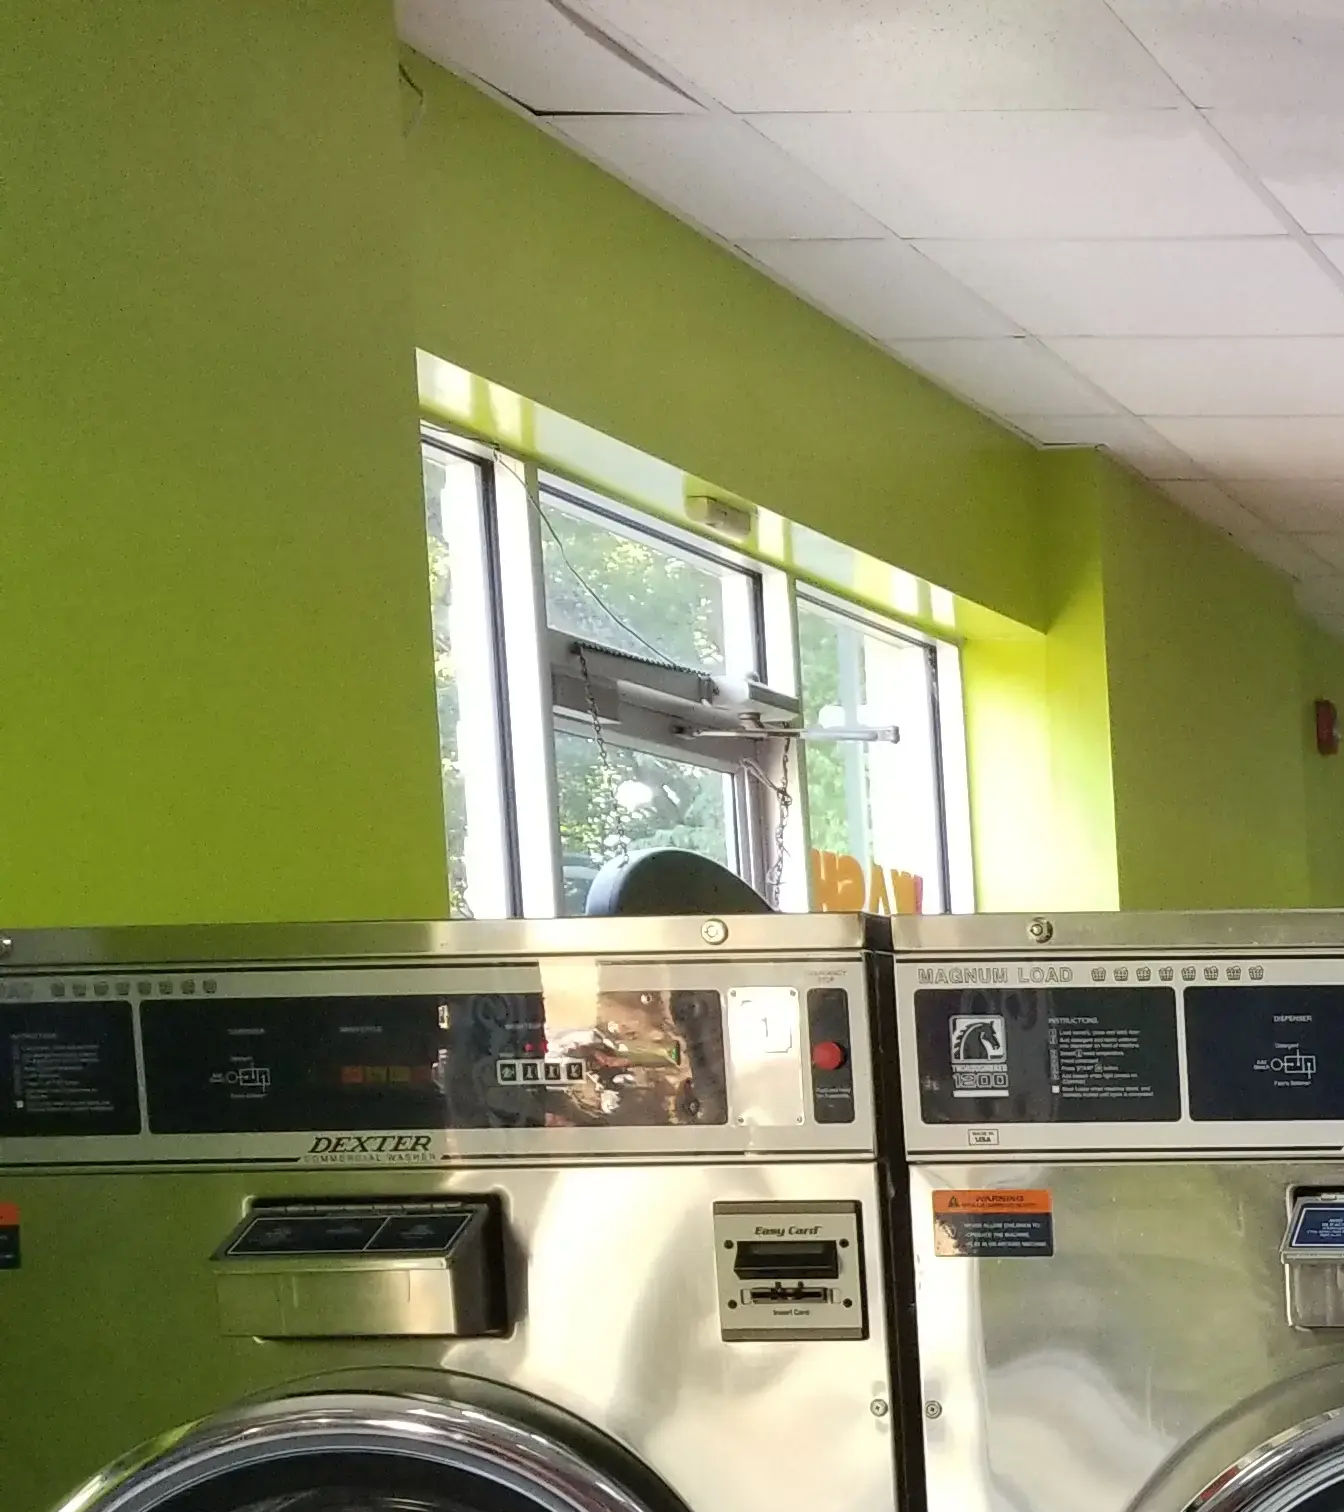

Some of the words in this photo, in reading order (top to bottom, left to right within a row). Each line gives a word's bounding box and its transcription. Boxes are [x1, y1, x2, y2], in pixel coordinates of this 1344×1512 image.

[918, 968, 1008, 984] MAGNUM
[1018, 967, 1073, 983] LOAD
[953, 1073, 1009, 1088] 1200
[308, 1135, 432, 1153] DEXTER
[754, 1227, 785, 1236] Easy
[788, 1226, 821, 1235] Card
